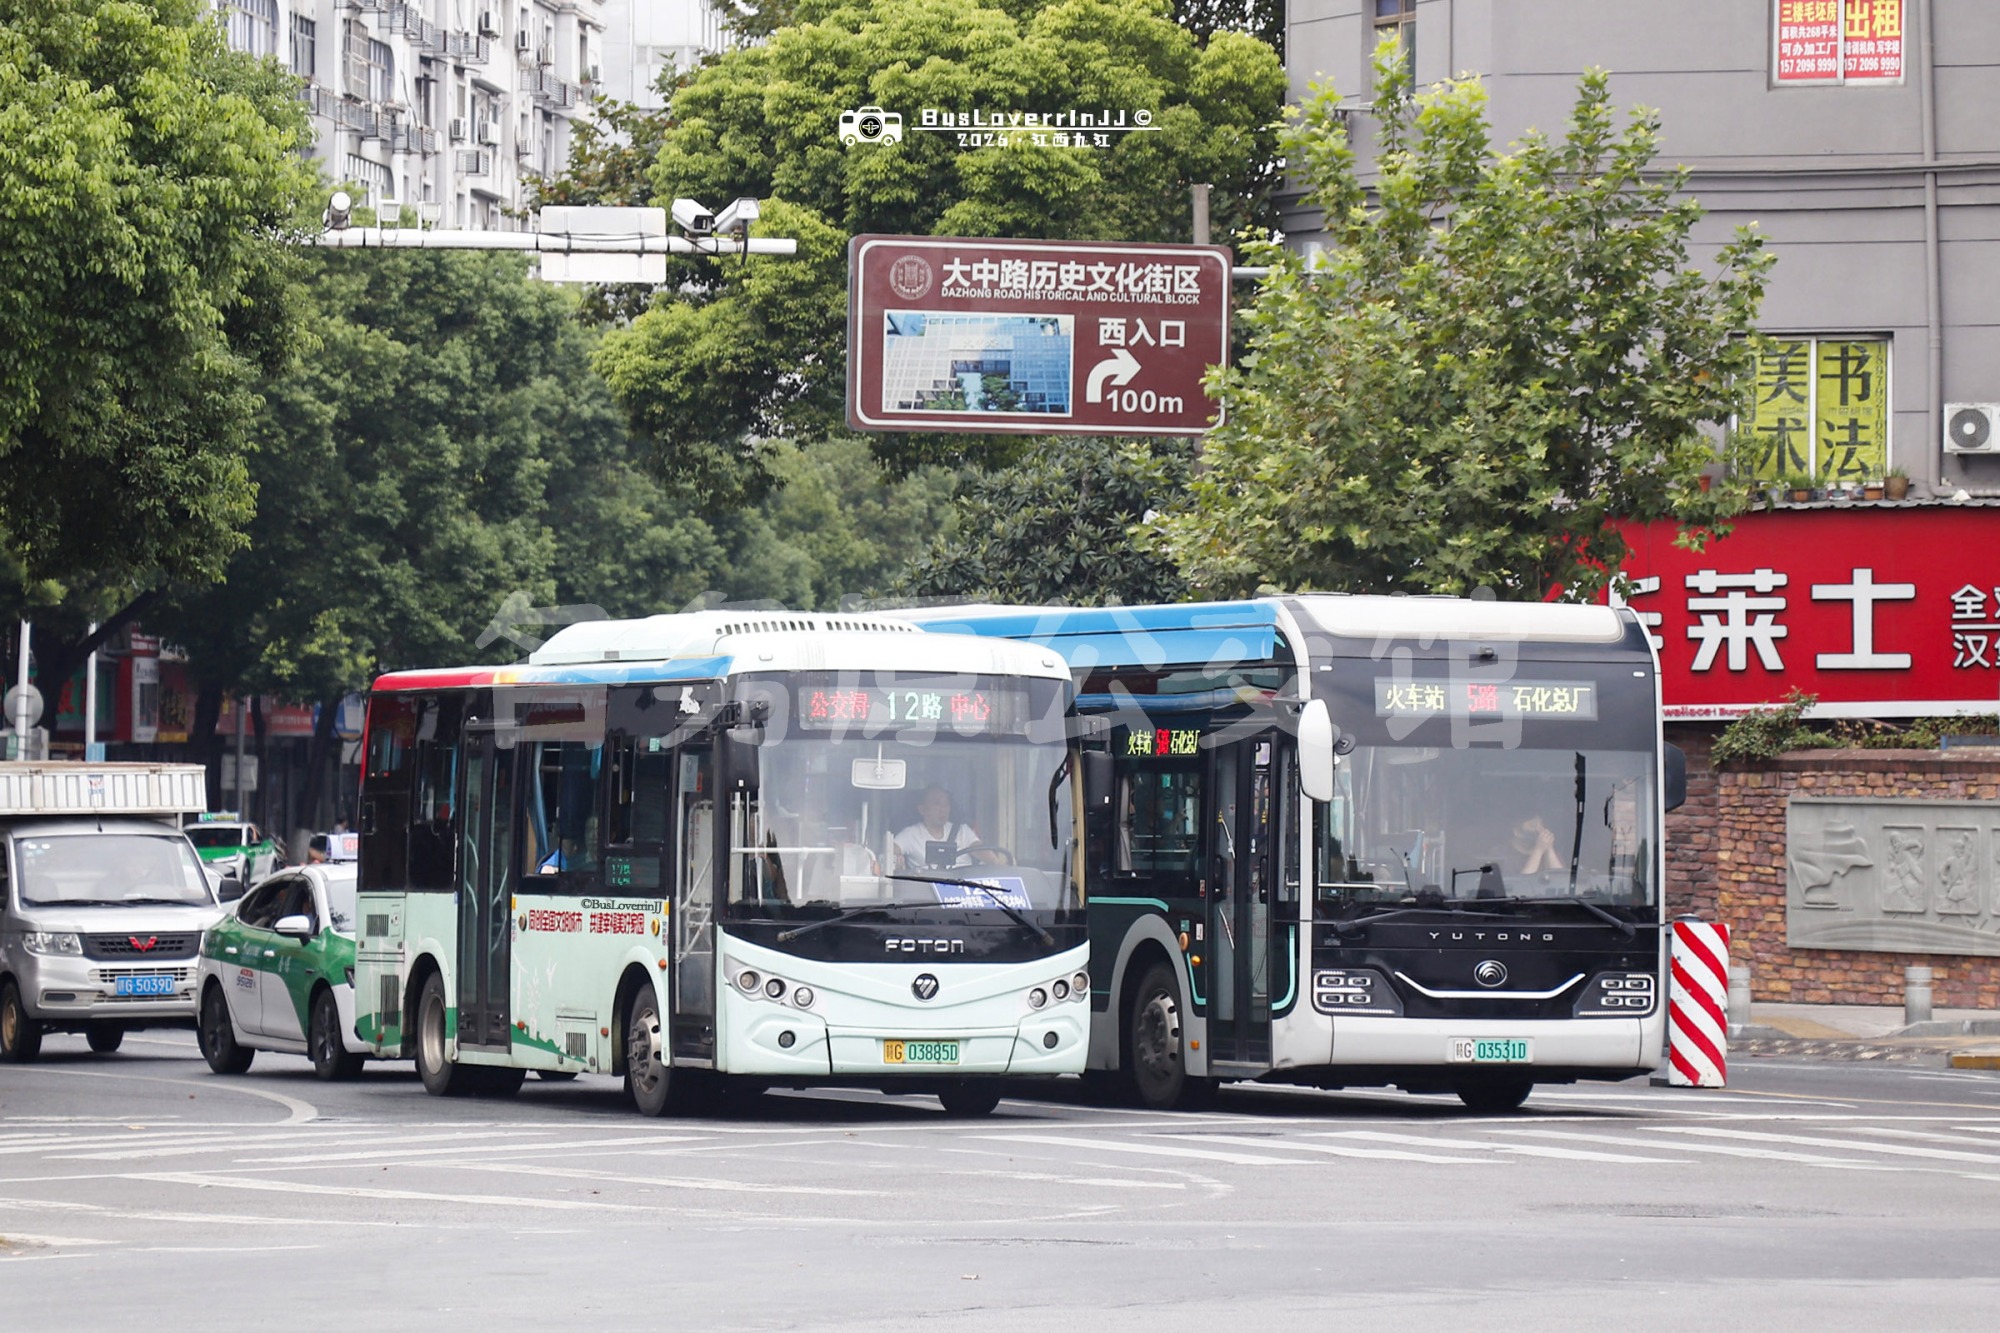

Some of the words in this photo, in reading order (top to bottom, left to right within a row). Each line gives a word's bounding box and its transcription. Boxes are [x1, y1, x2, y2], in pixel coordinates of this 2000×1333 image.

[1845, 1, 1900, 38] 出租
[1781, 42, 1837, 56] 可办加工厂
[1780, 59, 1794, 73] 157
[1796, 58, 1816, 72] 2096
[1817, 57, 1837, 72] 9990
[1859, 57, 1879, 71] 2096
[1880, 56, 1900, 71] 9990
[942, 257, 1201, 294] 大中路历史文化街区
[941, 287, 992, 298] DAZHONG
[993, 288, 1022, 299] ROAD
[1023, 289, 1085, 301] HISTORICAL
[1086, 291, 1109, 301] AND
[1109, 292, 1161, 303] CULTURAL
[1164, 293, 1200, 304] BLOCK
[1099, 317, 1186, 348] 西入口
[1106, 389, 1184, 414] 100m
[1951, 584, 2000, 619] 全
[1951, 633, 2000, 668] 汉
[887, 691, 943, 720] 12路
[1385, 683, 1445, 711] 火车站
[1467, 683, 1498, 712] 5路
[1513, 686, 1591, 712] 石化总厂
[1127, 729, 1152, 756] 火车站
[885, 939, 964, 953] FOTON
[1429, 932, 1553, 941] YUTONG
